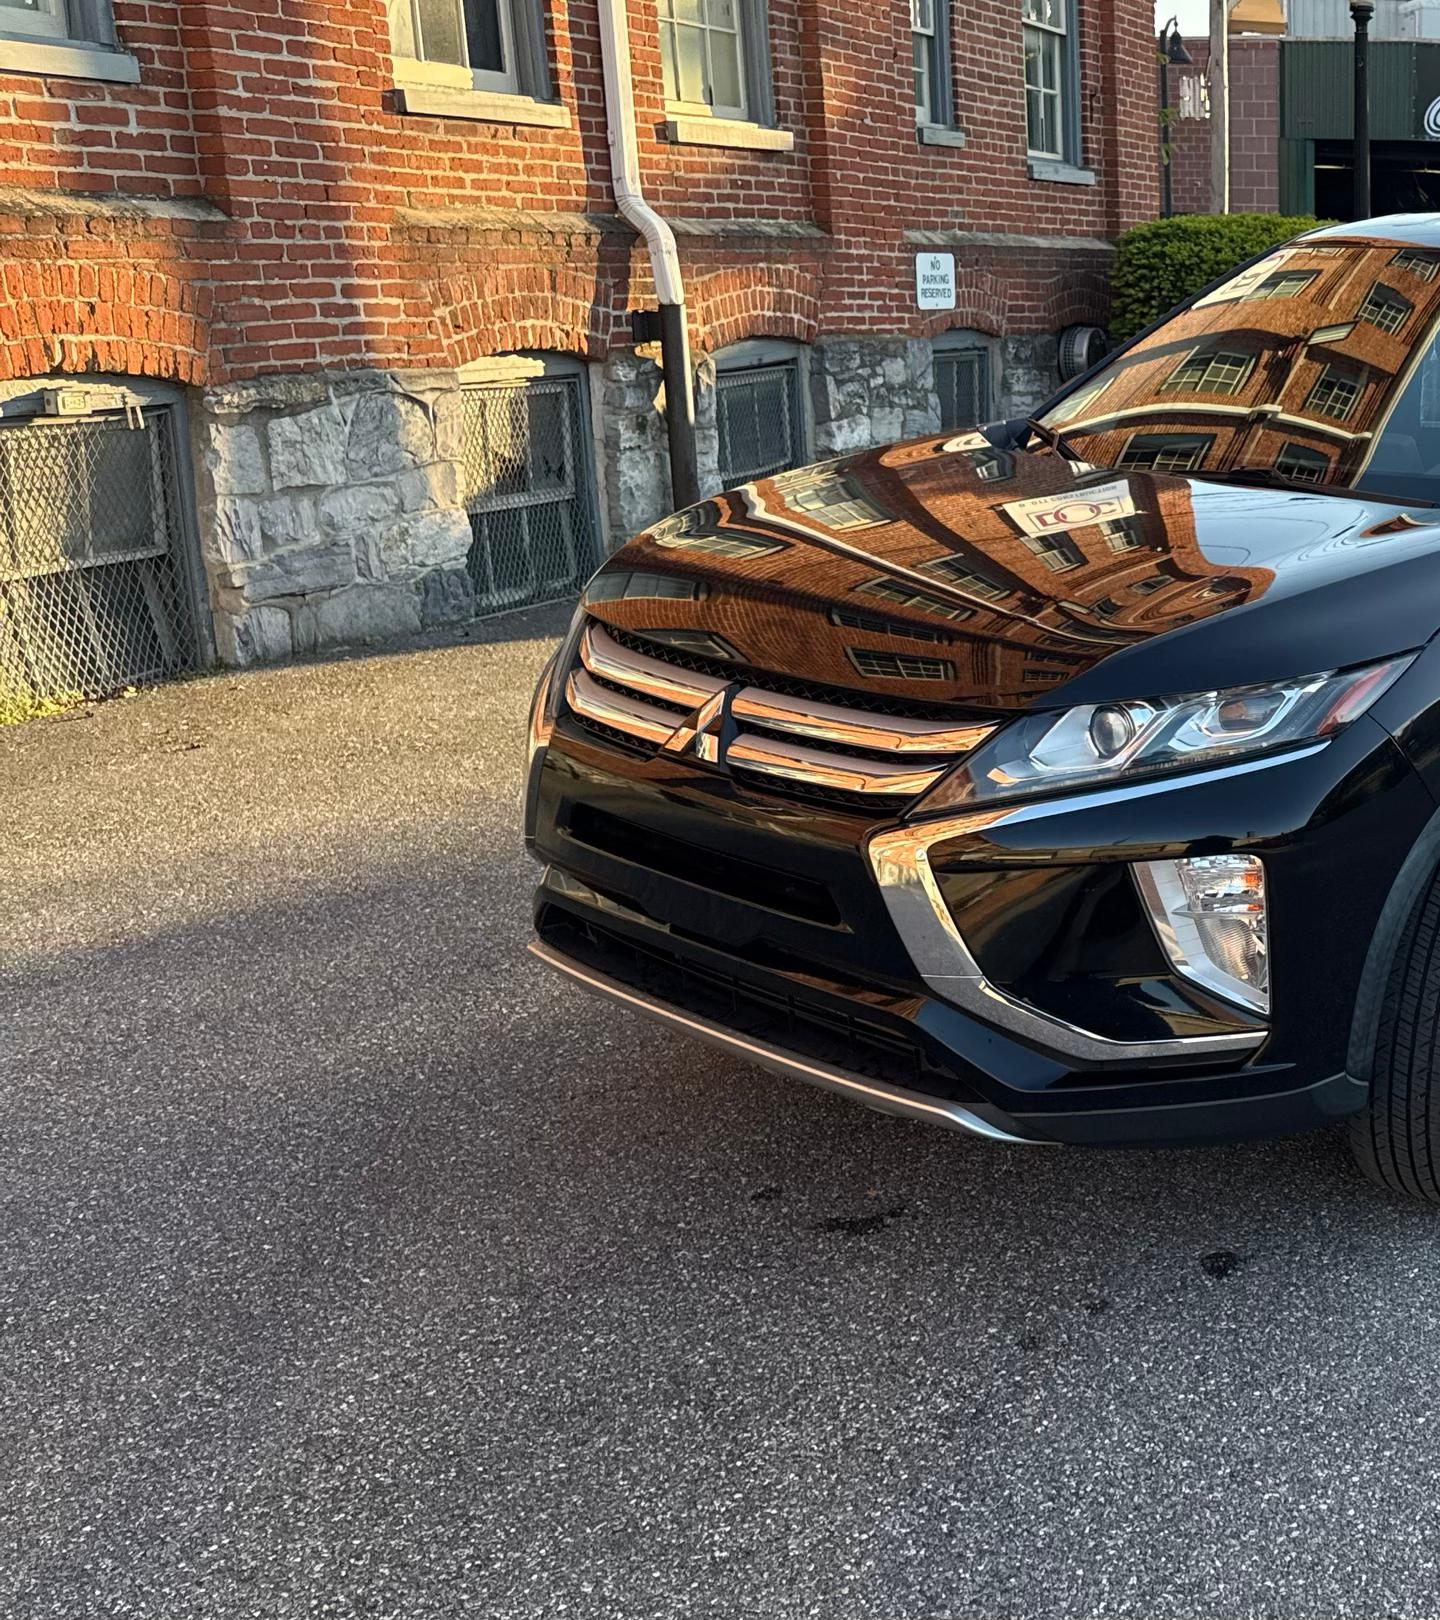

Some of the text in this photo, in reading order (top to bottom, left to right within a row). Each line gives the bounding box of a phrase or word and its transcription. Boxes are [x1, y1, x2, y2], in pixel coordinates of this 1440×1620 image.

[930, 260, 940, 270] NO
[922, 274, 949, 285] PARKING
[920, 288, 951, 298] RESERVED
